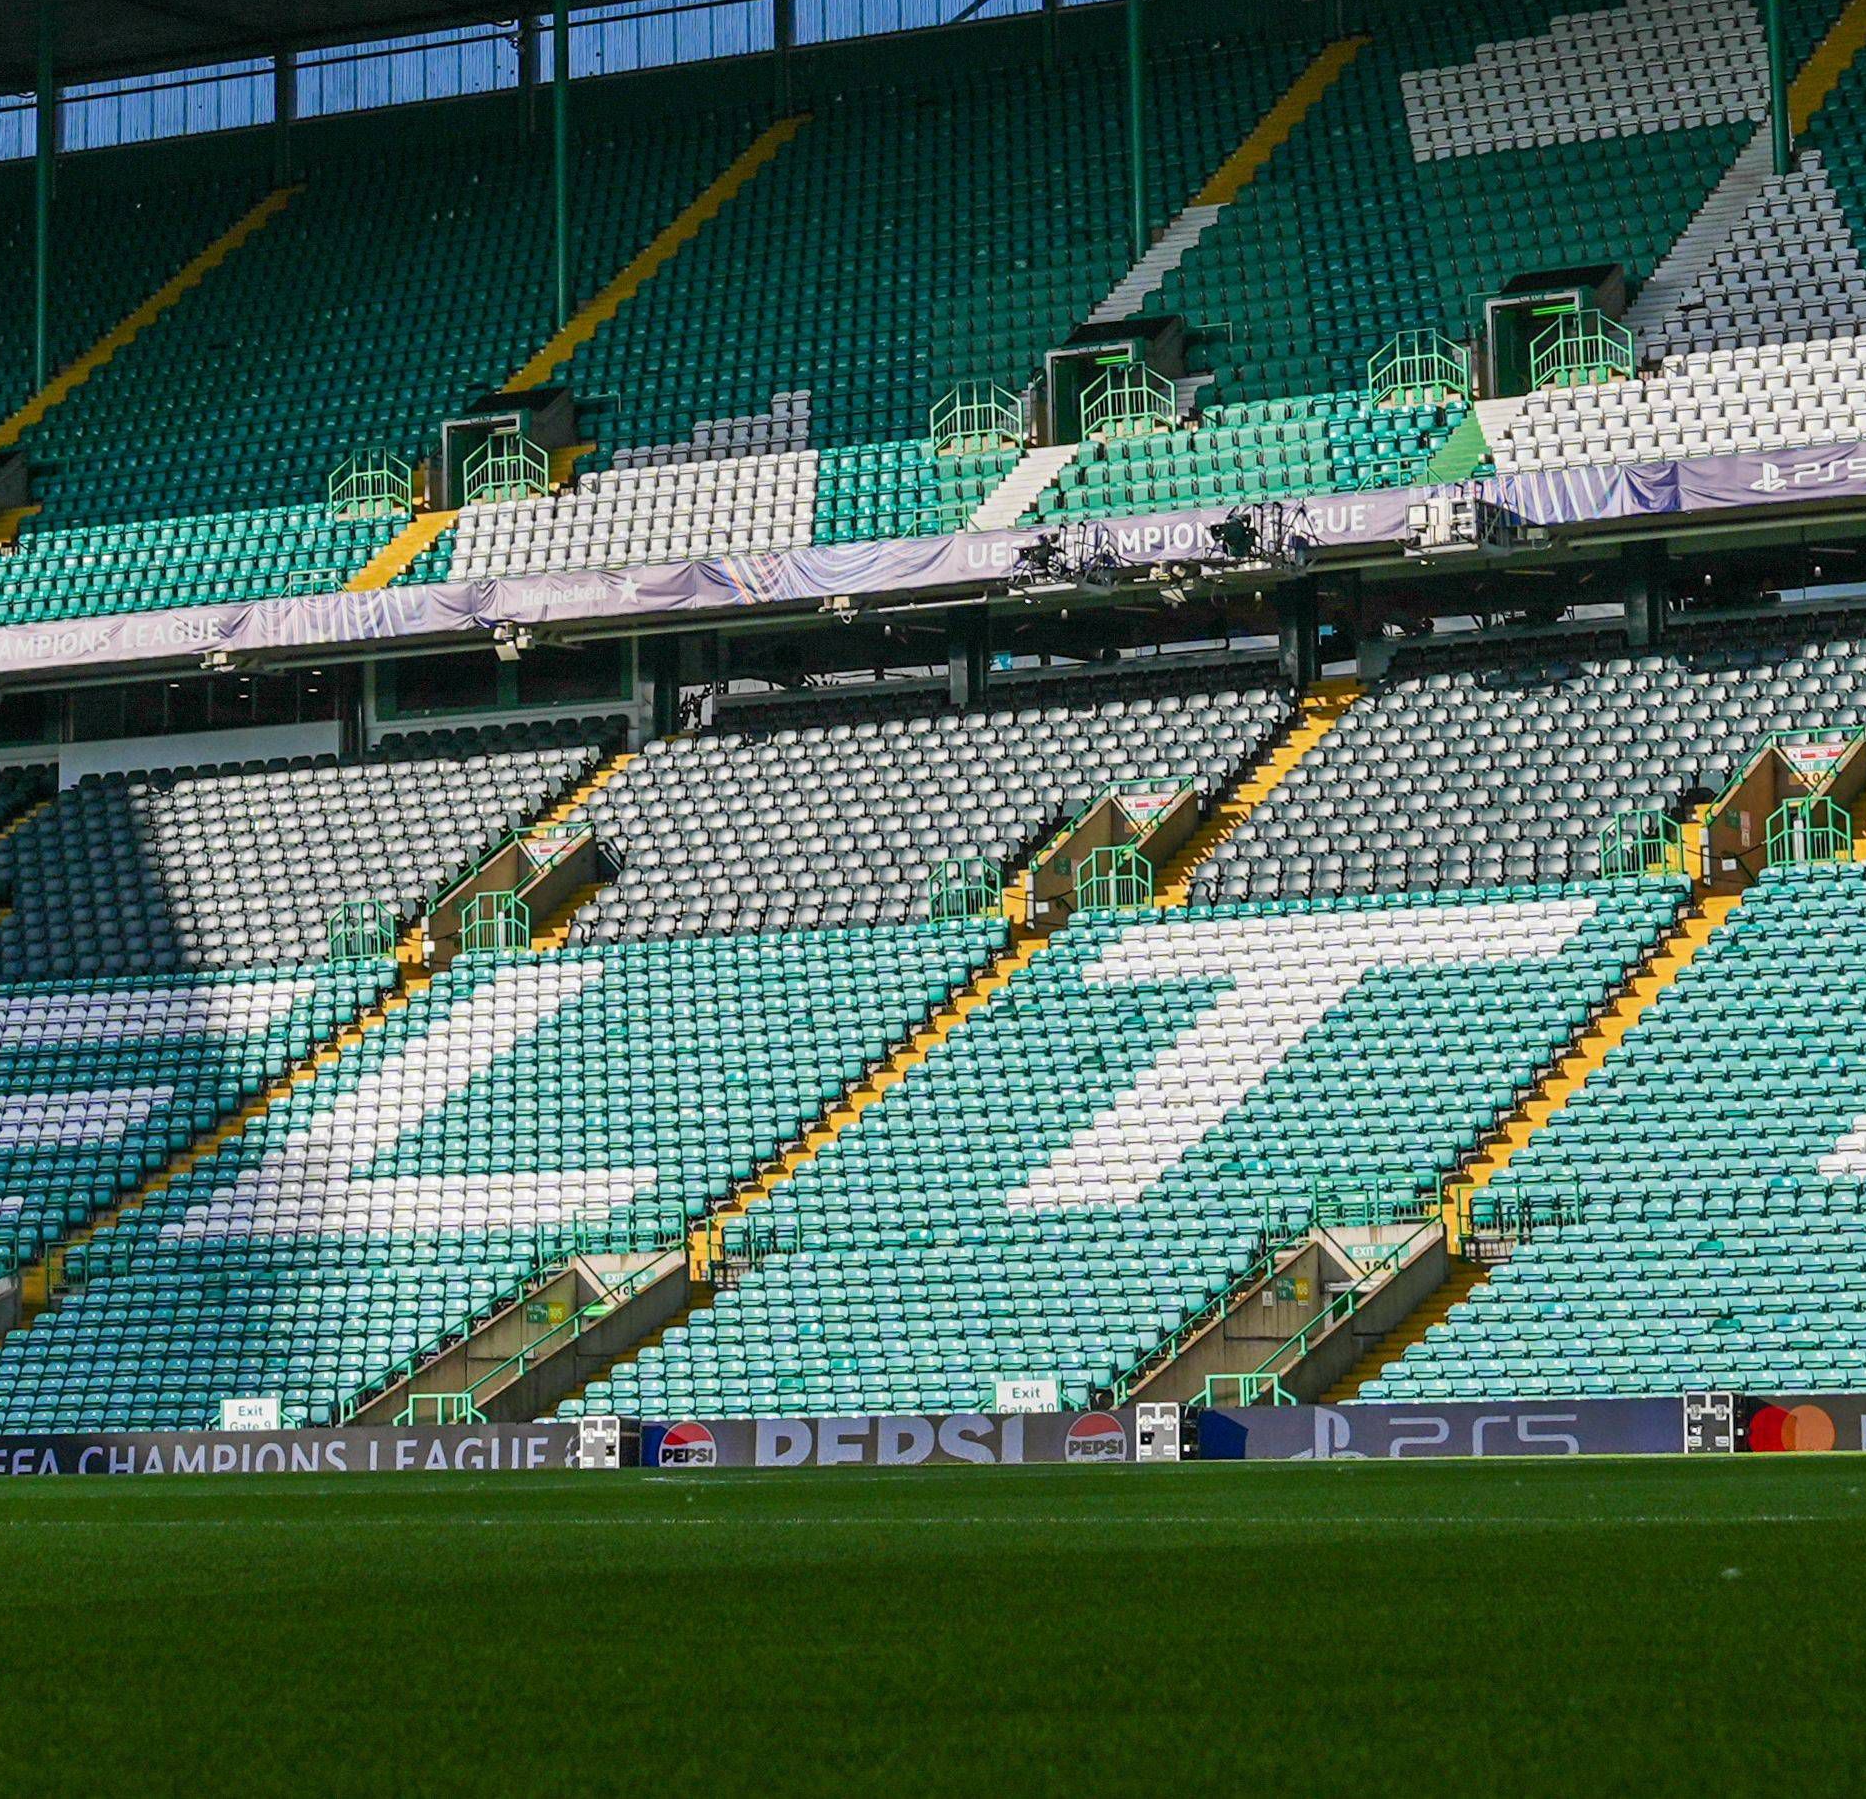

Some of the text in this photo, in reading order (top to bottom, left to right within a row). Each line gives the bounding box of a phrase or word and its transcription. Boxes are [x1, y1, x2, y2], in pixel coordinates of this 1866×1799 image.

[521, 581, 607, 606] Heineken
[122, 616, 223, 652] LEAGUE
[1352, 1246, 1375, 1257] EXIT
[1012, 1386, 1040, 1398] Exit
[238, 1405, 262, 1416] Exit
[998, 1402, 1055, 1414] Gate 10
[230, 1422, 258, 1430] Gate
[755, 1415, 1025, 1464] PEPSI
[1069, 1438, 1125, 1458] PEPSI
[77, 1439, 347, 1473] CHAMPIONS
[369, 1435, 549, 1470] LEAGUE
[660, 1446, 717, 1465] PEPSI
